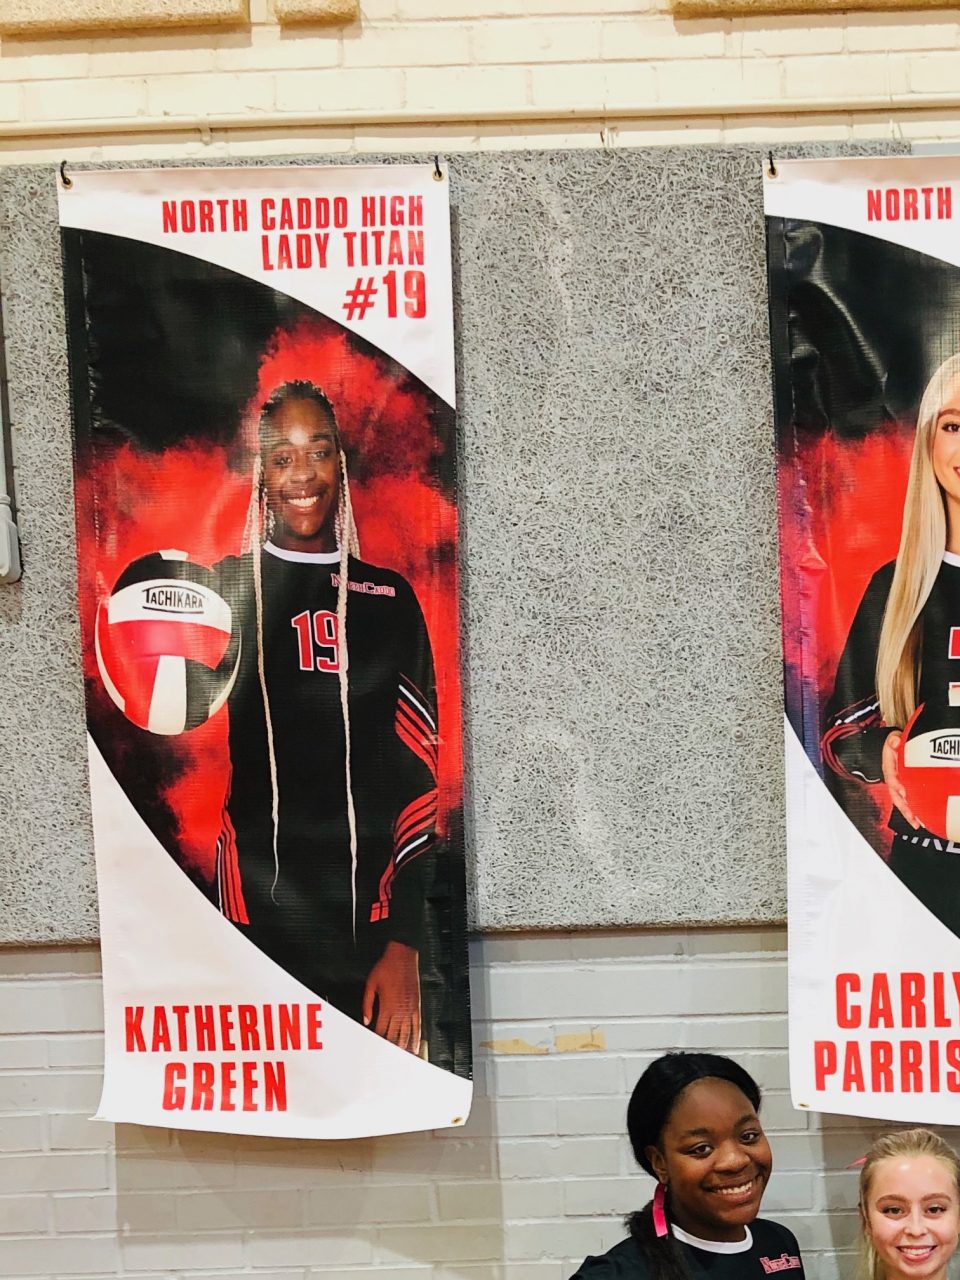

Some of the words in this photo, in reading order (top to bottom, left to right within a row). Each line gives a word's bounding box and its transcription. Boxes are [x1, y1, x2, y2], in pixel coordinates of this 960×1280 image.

[162, 198, 248, 233] NORTH
[261, 196, 348, 230] CADDO
[361, 195, 423, 227] HIGH
[867, 187, 952, 221] NORTH
[261, 232, 329, 271] LADY
[344, 230, 425, 267] TITAN
[342, 270, 427, 321] #19
[143, 588, 203, 608] TACHIKARA
[291, 610, 343, 674] 19
[124, 1003, 323, 1053] KATHERINE
[162, 1061, 288, 1112] GREEN
